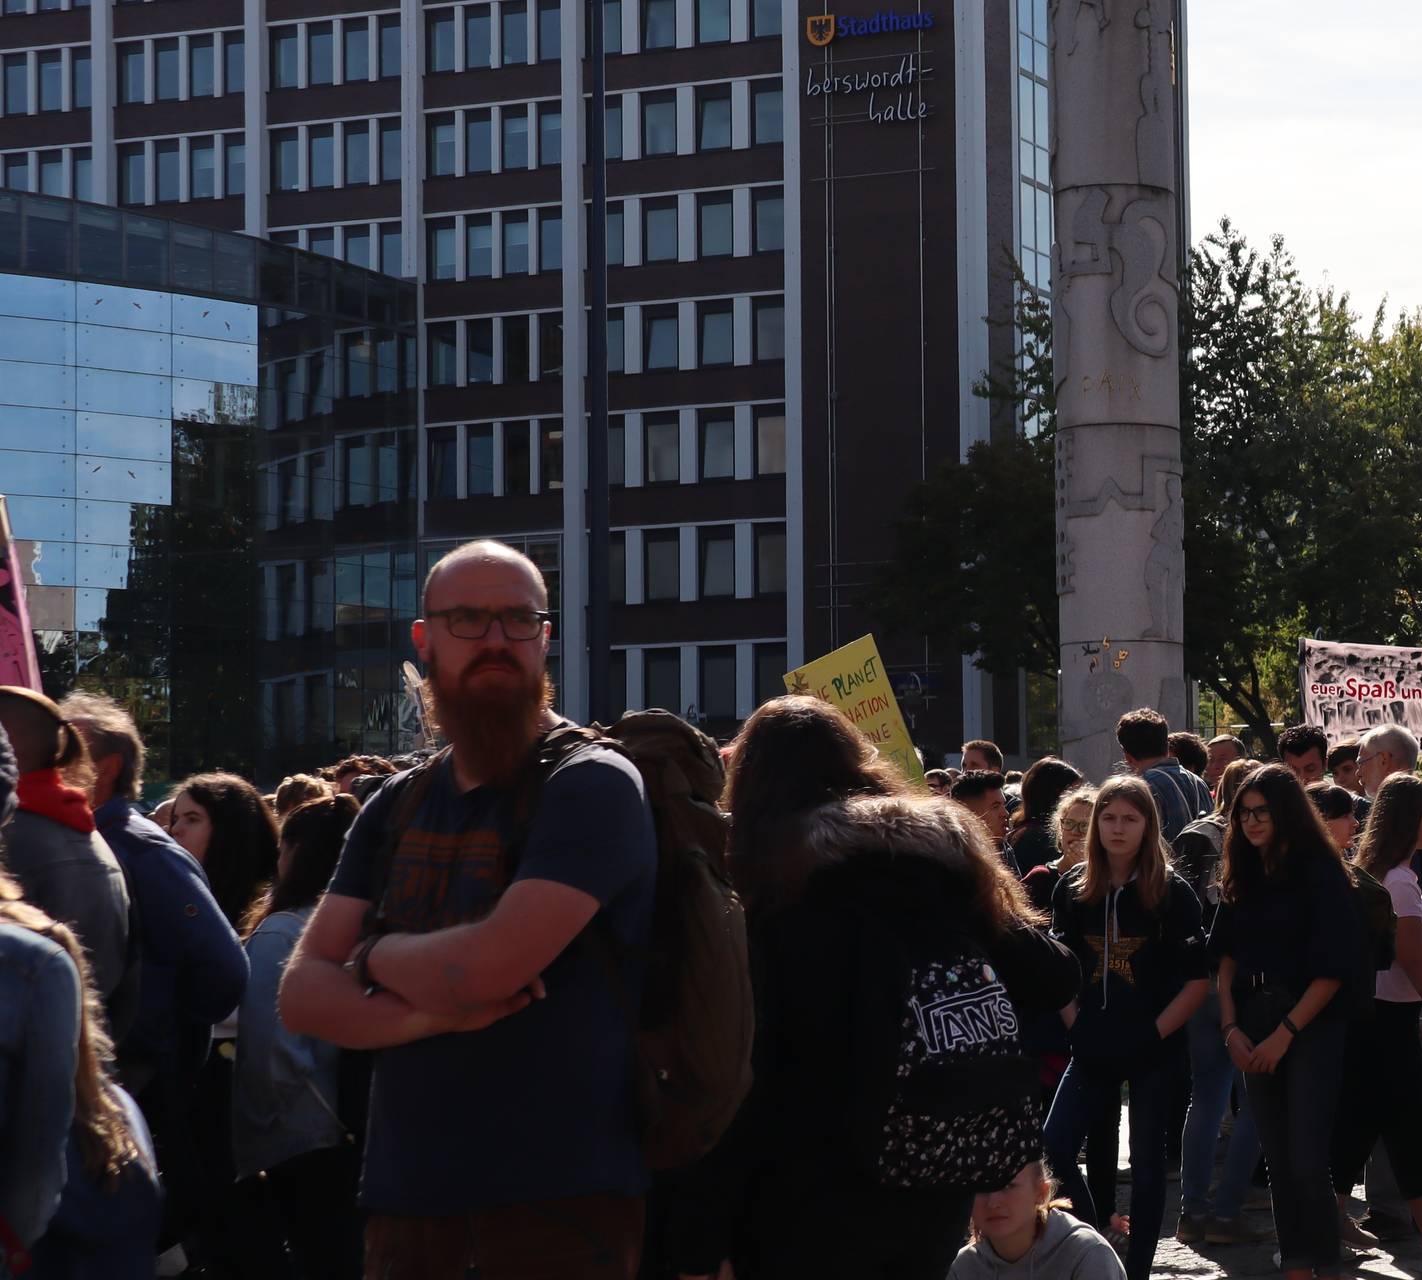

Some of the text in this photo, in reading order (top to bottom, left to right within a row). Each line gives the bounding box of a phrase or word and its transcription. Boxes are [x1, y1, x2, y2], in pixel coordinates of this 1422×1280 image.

[837, 10, 934, 38] Stadthaus
[807, 54, 934, 96] berswordt-
[869, 92, 928, 124] halle
[832, 655, 878, 701] PLANET
[1311, 683, 1342, 696] euer
[1345, 678, 1396, 701] Spaß
[912, 984, 1018, 1053] VANS
